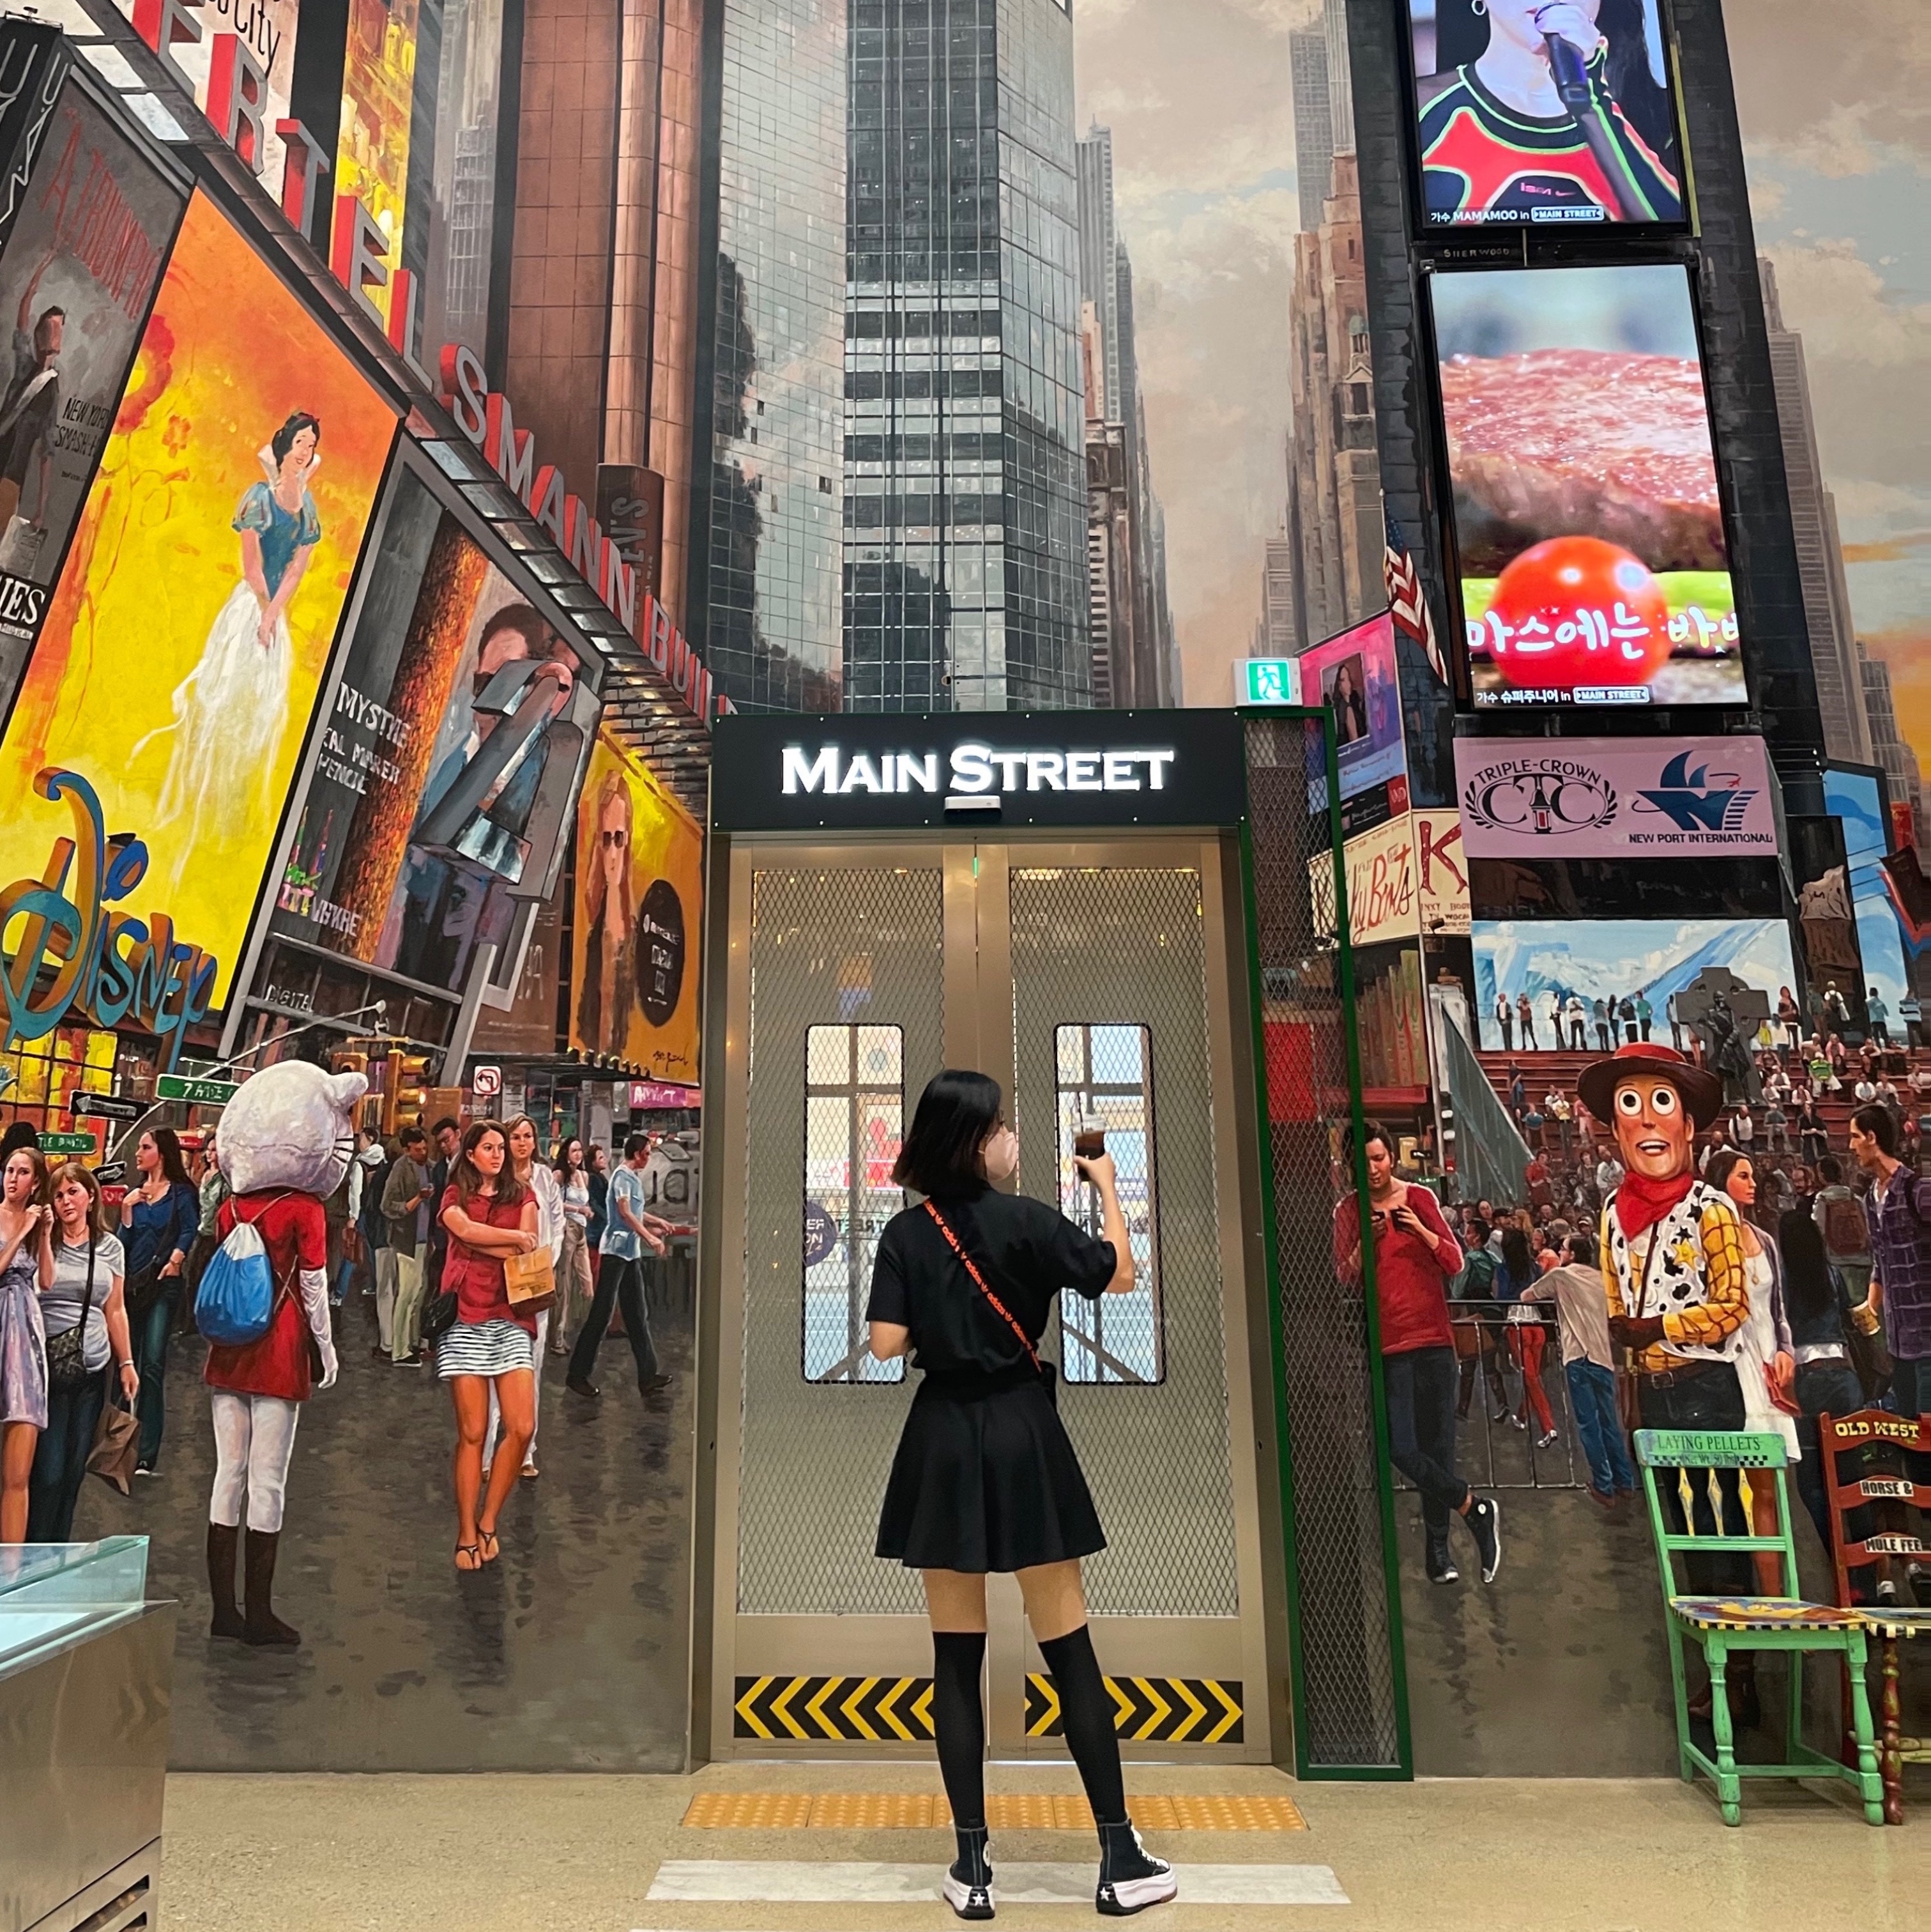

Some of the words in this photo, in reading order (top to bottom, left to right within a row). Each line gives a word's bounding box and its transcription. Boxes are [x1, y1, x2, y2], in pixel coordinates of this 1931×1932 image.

[1431, 211, 1451, 223] 가수
[1453, 210, 1518, 222] MAMAMOO
[1520, 211, 1529, 220] in
[1538, 210, 1562, 218] MAIN
[1564, 209, 1597, 218] STREET
[643, 595, 738, 732] BUIL
[1477, 691, 1498, 703] 가수
[1561, 691, 1571, 702] in
[1581, 690, 1605, 700] MAIN
[1607, 690, 1642, 700] STREET
[781, 747, 937, 795] MAIN
[950, 745, 1174, 793] STREET
[1474, 759, 1601, 785] TRIPLE-CROWN
[1629, 834, 1654, 843] NEW
[1658, 833, 1686, 843] PORT
[1688, 832, 1774, 843] INTERNATIONAL
[1835, 1421, 1870, 1437] OLD
[1873, 1421, 1920, 1438] WEST
[1658, 1434, 1703, 1450] LAYING
[1706, 1436, 1761, 1451] PELLETS
[1861, 1481, 1901, 1495] HORSE
[1904, 1481, 1912, 1495] &
[1865, 1538, 1898, 1552] MULE
